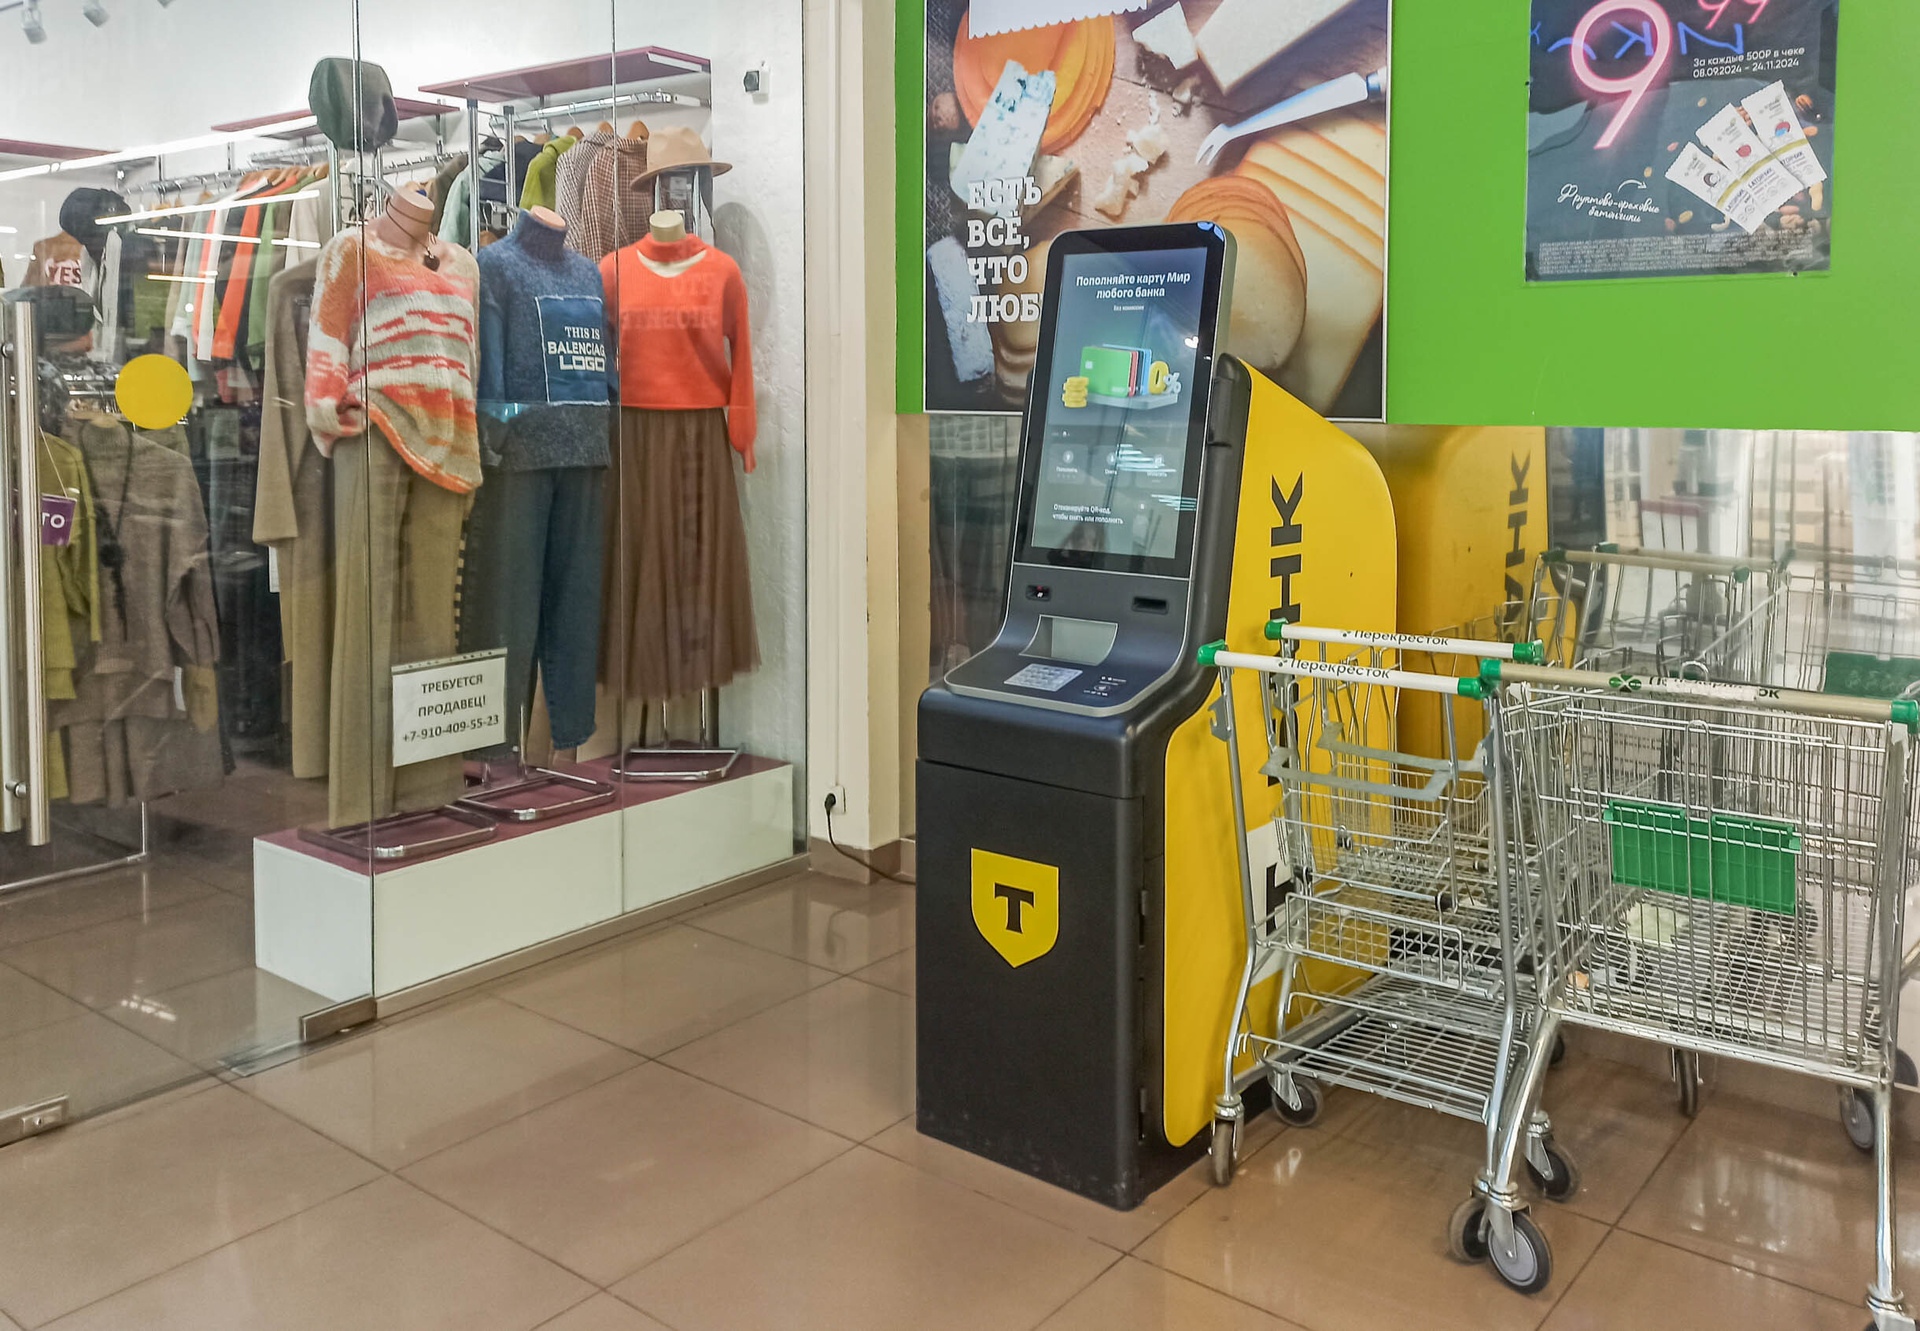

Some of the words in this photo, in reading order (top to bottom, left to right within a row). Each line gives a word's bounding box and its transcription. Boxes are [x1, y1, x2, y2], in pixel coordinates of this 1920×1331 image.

[1693, 58, 1706, 67] За
[1708, 55, 1744, 65] каждые
[1781, 47, 1805, 56] чеке
[1571, 0, 1673, 150] 9
[1693, 65, 1742, 78] 08.09.2024
[1752, 58, 1799, 72] 24.11.2024
[967, 176, 1042, 210] ЕСТЬ
[967, 211, 1030, 250] ВСЁ,
[47, 266, 82, 285] YES
[967, 255, 1028, 285] ЧТО
[1076, 274, 1136, 287] Пополняйте
[1136, 273, 1166, 285] карту
[1167, 272, 1191, 284] Мир
[1096, 288, 1134, 299] любого
[1135, 286, 1166, 298] банка
[967, 293, 1043, 323] ЛЮБ
[564, 326, 591, 339] THIS
[591, 328, 601, 340] IS
[547, 341, 607, 361] BALENCIAG
[559, 355, 606, 373] LOGO
[421, 673, 483, 694] ТРЕБУЕТСЯ
[418, 695, 486, 717] ПРОДАВЕЦ!
[402, 714, 499, 742] +7-910-409-55-23
